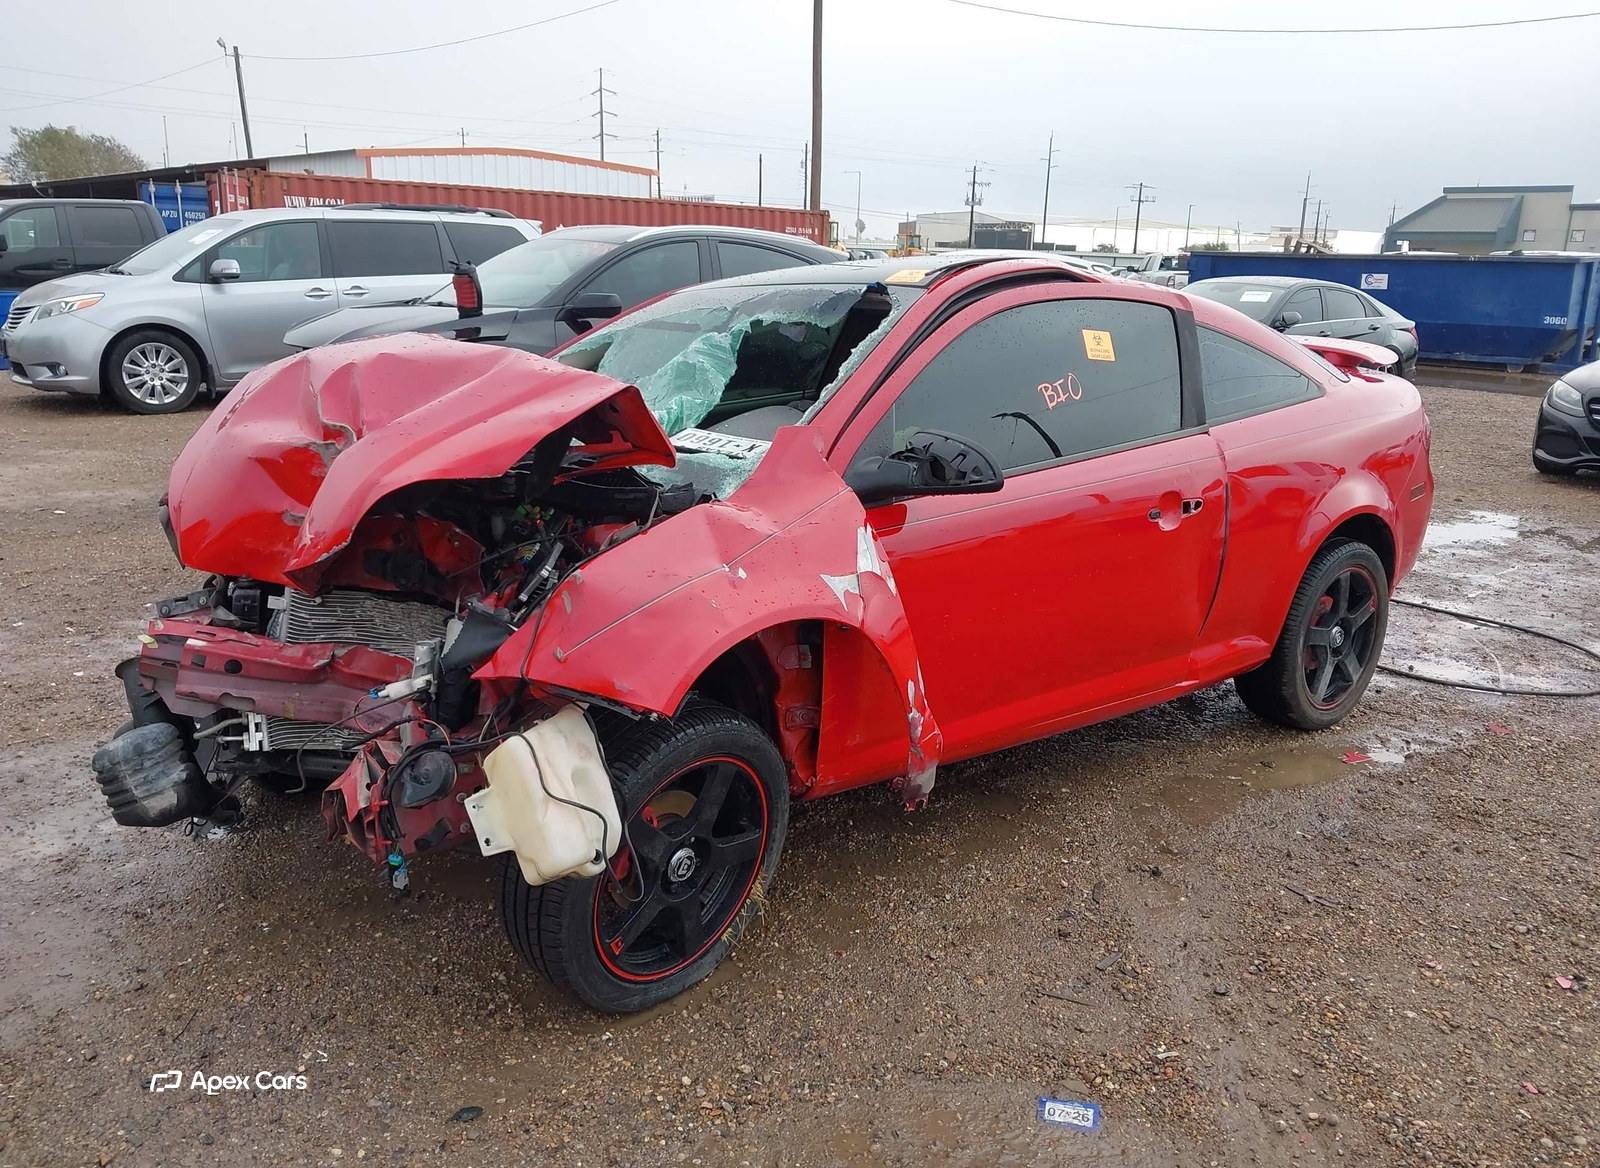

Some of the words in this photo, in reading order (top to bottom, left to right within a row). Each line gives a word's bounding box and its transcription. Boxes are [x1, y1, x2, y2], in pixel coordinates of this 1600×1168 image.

[283, 195, 345, 208] WWWZIMCOM
[161, 210, 178, 218] APZU
[184, 211, 206, 220] 450250
[1543, 315, 1568, 325] 3060
[1037, 372, 1083, 411] BIO
